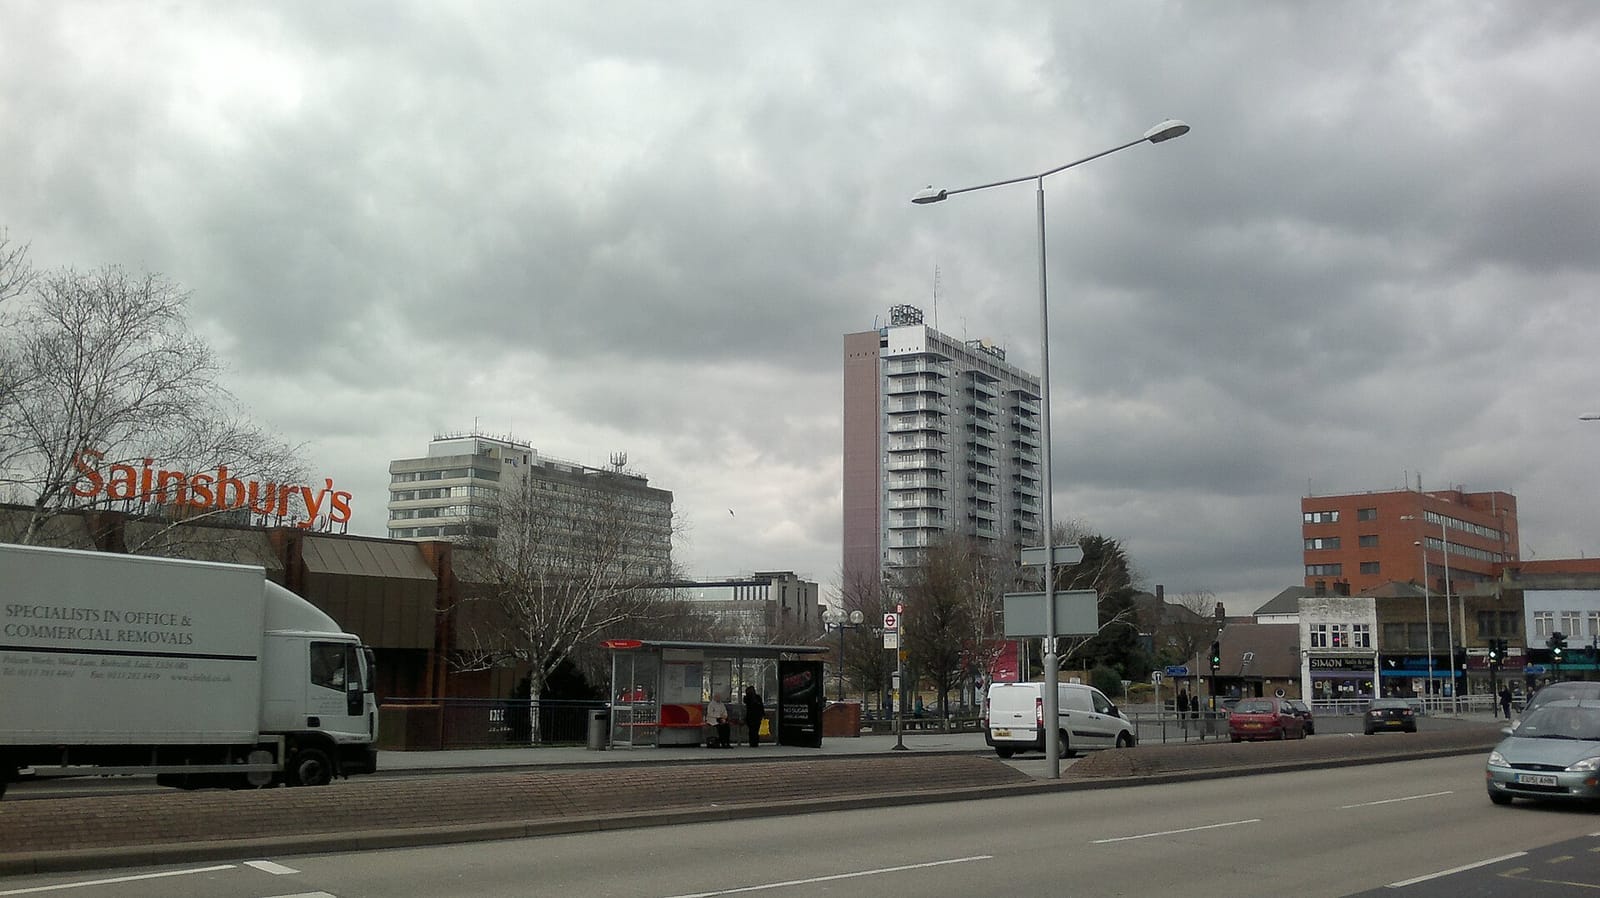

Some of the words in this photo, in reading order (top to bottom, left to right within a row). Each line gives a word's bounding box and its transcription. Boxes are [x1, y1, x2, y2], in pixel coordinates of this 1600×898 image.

[70, 448, 352, 528] Sainsbury's
[5, 604, 100, 622] SPECIALISTS
[104, 609, 121, 623] IN
[124, 611, 178, 626] OFFICE
[181, 615, 192, 627] &
[4, 623, 113, 642] COMMERCIAL
[116, 630, 193, 646] REMOVALS
[1311, 658, 1342, 668] SIMON
